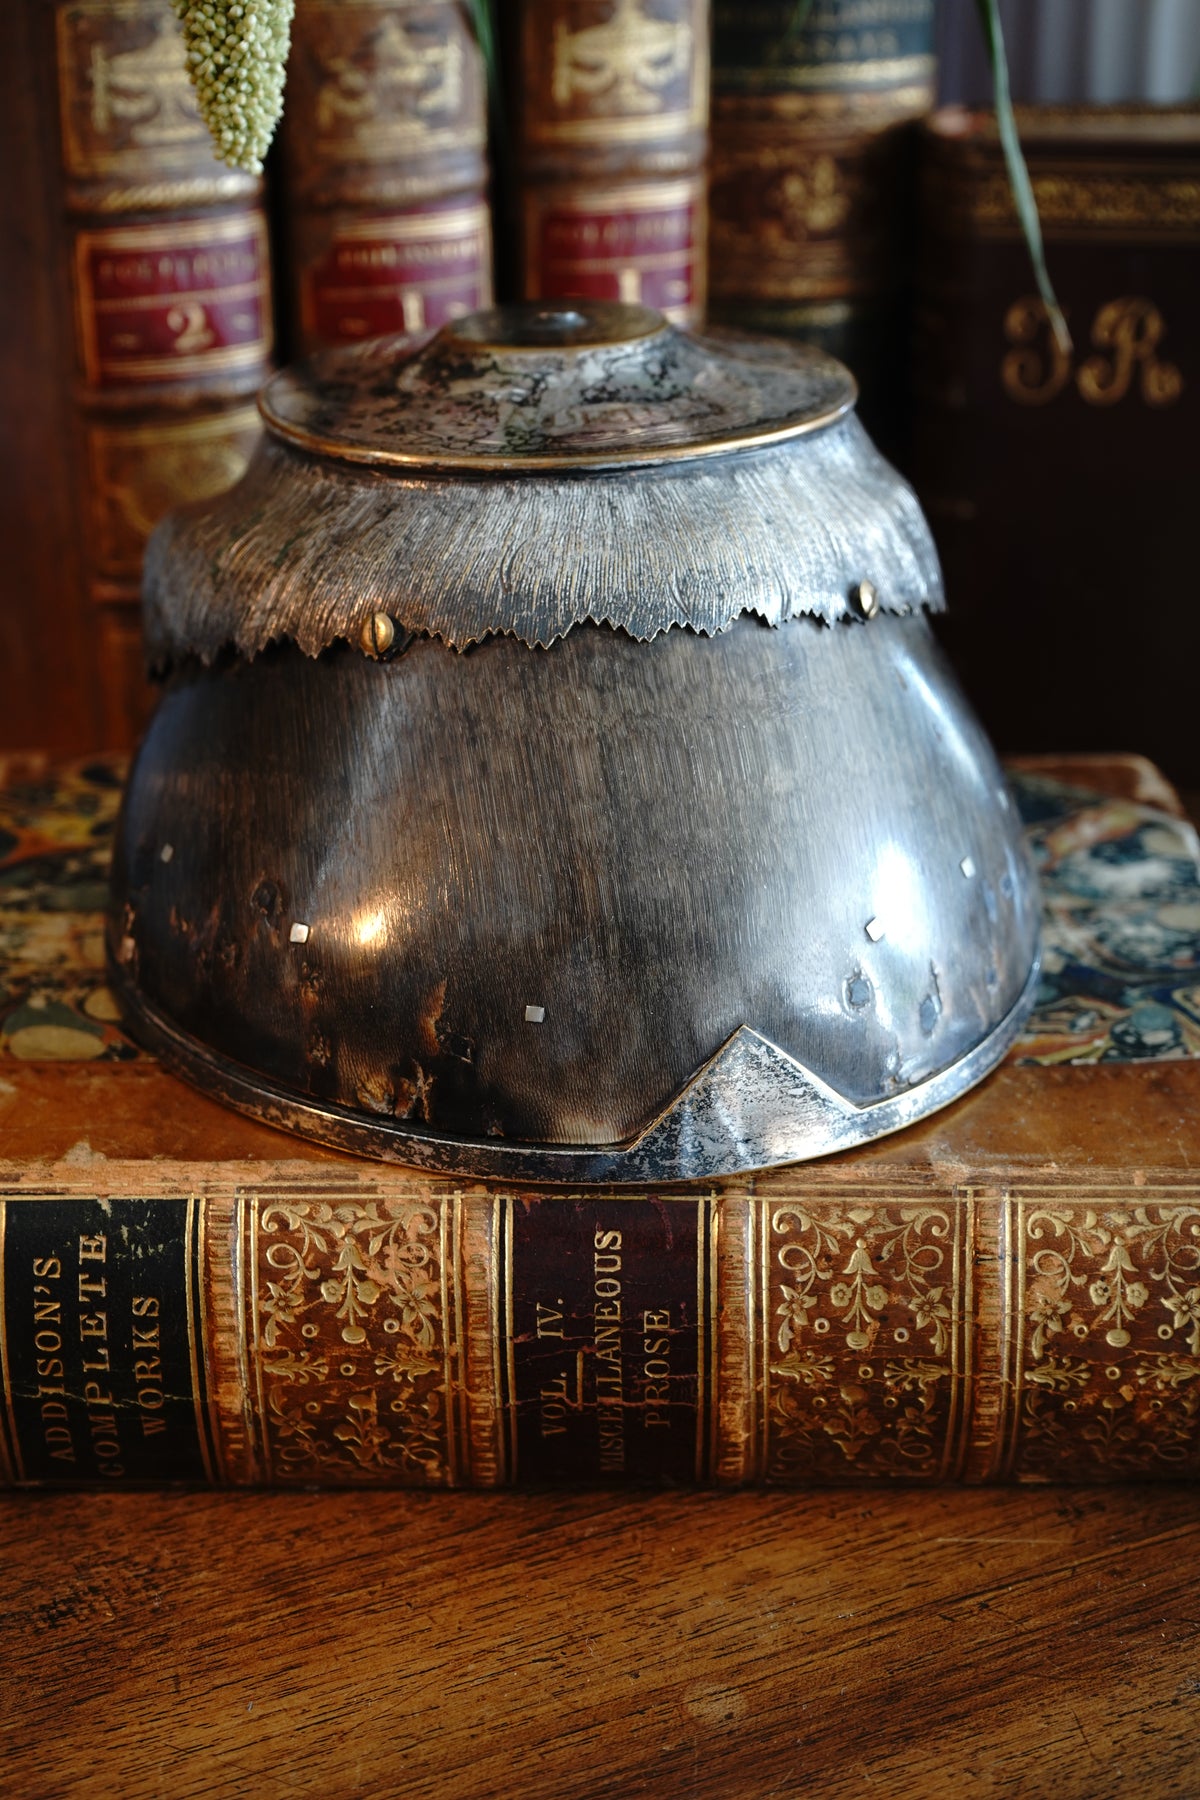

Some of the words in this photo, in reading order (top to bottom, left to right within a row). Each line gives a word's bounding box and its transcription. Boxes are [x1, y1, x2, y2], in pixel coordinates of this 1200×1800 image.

[32, 1256, 76, 1461] ADDISON'S
[78, 1234, 124, 1476] COMPLETE
[132, 1295, 168, 1437] WORKS
[536, 1298, 564, 1339] IV.
[593, 1229, 625, 1472] MISCELLANEOUS
[643, 1308, 672, 1428] PROSE
[540, 1371, 568, 1438] VOL.
